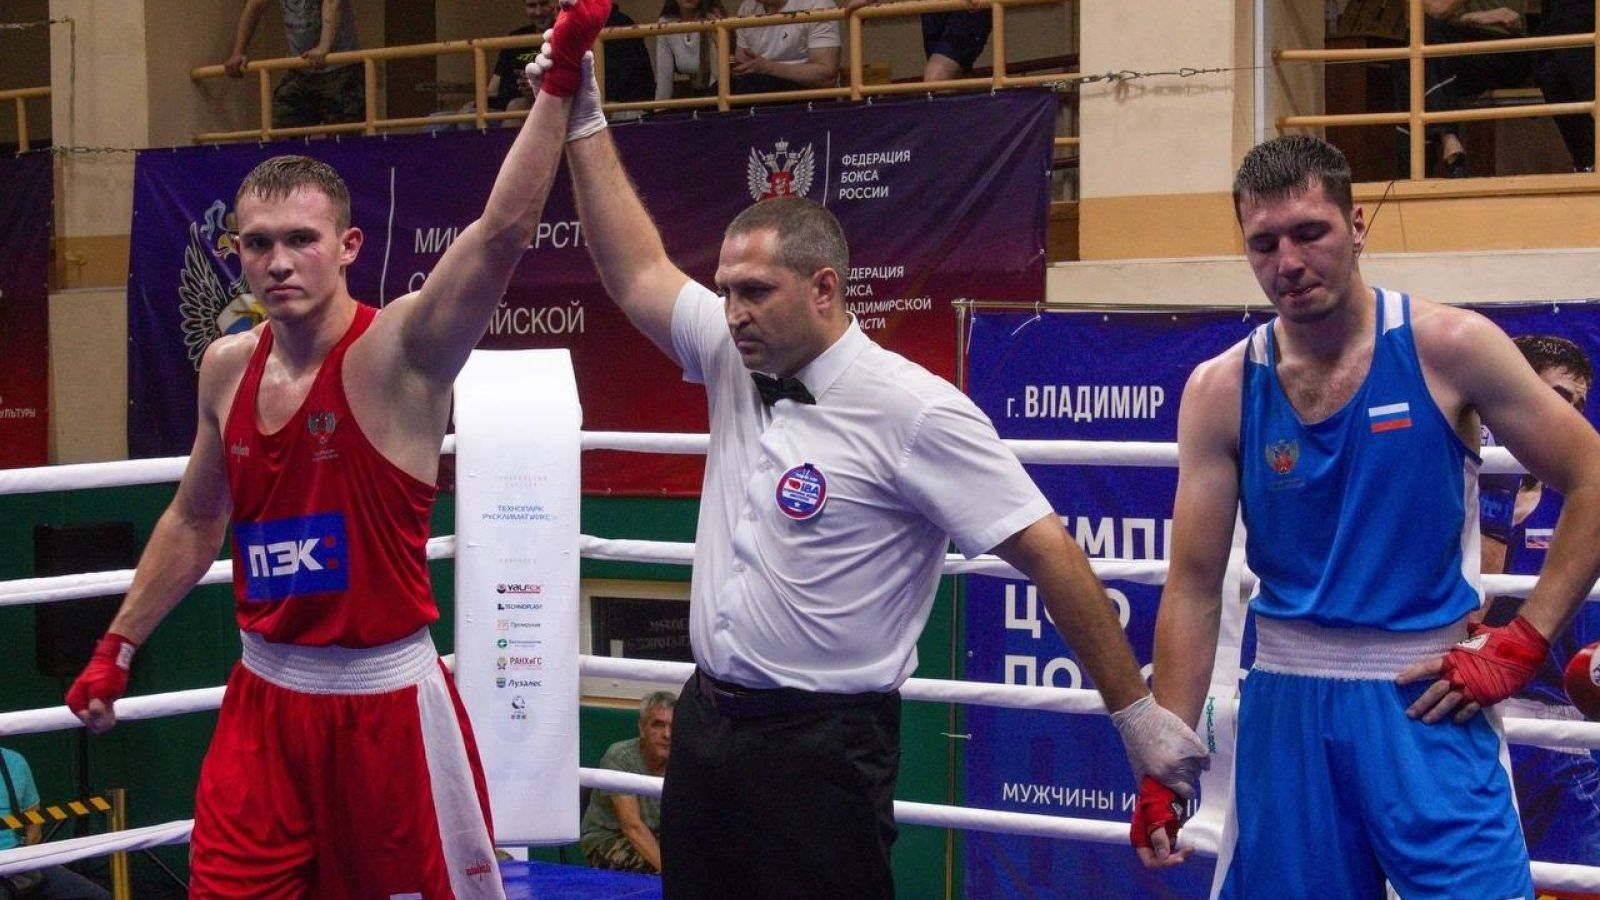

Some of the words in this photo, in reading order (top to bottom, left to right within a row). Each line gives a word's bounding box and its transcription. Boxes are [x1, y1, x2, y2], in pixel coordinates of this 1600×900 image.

[841, 150, 911, 167] ФЕДЕРАЦИЯ
[840, 169, 879, 184] БОКСА
[839, 186, 889, 200] РОССИИ
[847, 265, 905, 281] ЕДЕРАЦИЯ
[845, 296, 932, 315] АДИМИРСКОЙ
[490, 300, 585, 335] ЙСКОЙ
[860, 317, 886, 330] АСТИ
[1006, 397, 1020, 418] г.
[1024, 385, 1165, 422] ВЛАДИМИР
[497, 504, 545, 513] ТЕХНОПАРК
[1002, 782, 1114, 811] МУЖЧИНЫ
